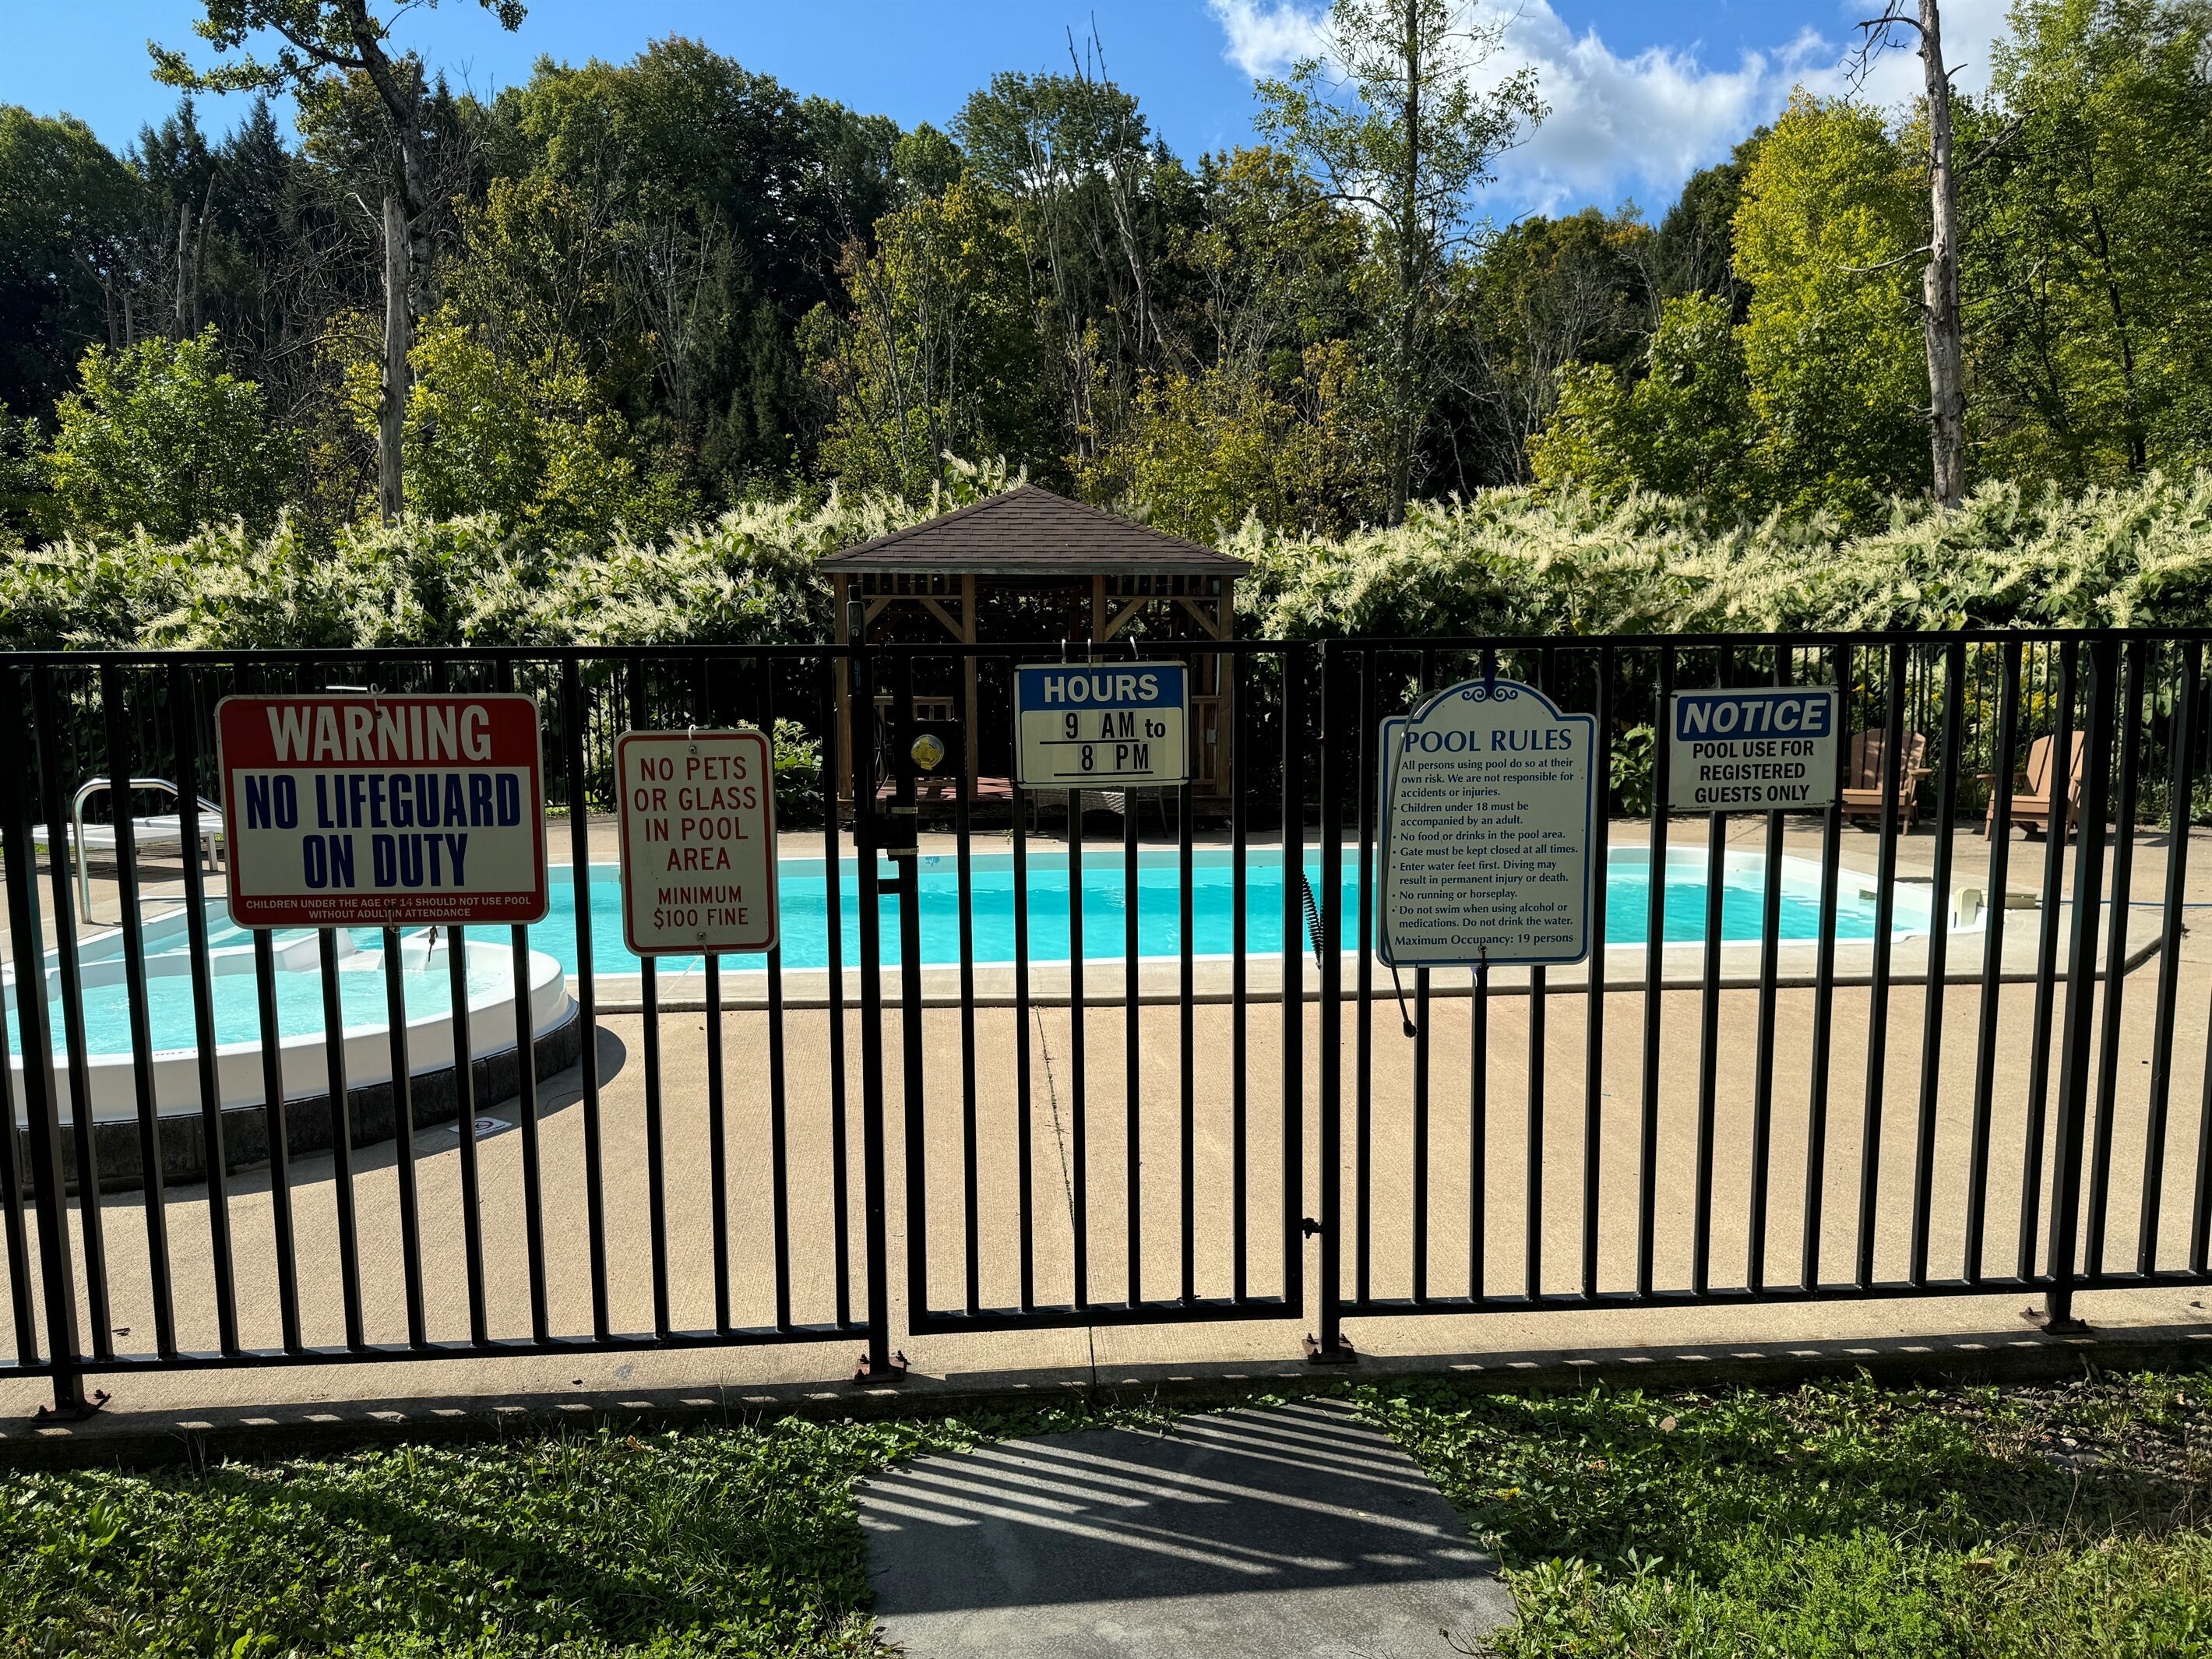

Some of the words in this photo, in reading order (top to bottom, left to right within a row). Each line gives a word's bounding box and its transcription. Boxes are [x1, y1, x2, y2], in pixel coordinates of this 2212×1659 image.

[1044, 675, 1158, 702] HOURS
[1683, 699, 1826, 734] NOTICE
[266, 705, 491, 762] WARNING
[1065, 713, 1078, 739] 9
[1101, 712, 1134, 738] AM
[1145, 719, 1165, 738] to
[1405, 731, 1481, 752] POOL
[1491, 728, 1572, 752] RULES
[1081, 745, 1093, 771] 8
[1116, 744, 1148, 770] PM
[1693, 742, 1738, 759] POOL
[1743, 741, 1776, 757] USE
[1781, 741, 1813, 756] FOR
[640, 757, 673, 781] NO
[687, 756, 746, 780] PETS
[1402, 759, 1414, 770] All
[1418, 759, 1454, 772] persons
[1458, 759, 1482, 770] using
[1486, 758, 1506, 770] pool
[1510, 758, 1522, 768] do
[1538, 759, 1548, 767] at
[1551, 757, 1573, 766] their
[1700, 763, 1805, 780] REGISTERED
[1401, 775, 1421, 784] own
[1425, 773, 1444, 783] risk.
[1447, 773, 1463, 783] We
[1485, 773, 1500, 782] not
[1503, 771, 1557, 784] responsible
[1560, 771, 1574, 780] for
[634, 788, 667, 812] OR
[679, 787, 756, 811] GLASS
[1401, 787, 1446, 798] accidents
[1449, 788, 1459, 797] or
[1463, 787, 1500, 798] injuries.
[1695, 786, 1762, 803] GUESTS
[1767, 785, 1810, 801] ONLY
[245, 775, 298, 830] NO
[315, 773, 520, 829] LIFEGUARD
[1400, 802, 1441, 812] Children
[1445, 802, 1472, 812] under
[1477, 802, 1488, 811] 18
[1517, 801, 1528, 810] be
[645, 818, 668, 841] IN
[682, 816, 748, 841] POOL
[1400, 815, 1464, 828] accompanied
[1467, 815, 1478, 827] by
[1496, 815, 1523, 824] adult.
[1400, 831, 1414, 841] No
[1418, 830, 1439, 840] food
[1456, 830, 1485, 840] drinks
[1488, 830, 1497, 839] in
[1500, 830, 1515, 839] the
[1518, 830, 1539, 841] pool
[667, 847, 731, 871] AREA
[1400, 847, 1423, 856] Gate
[1453, 845, 1464, 855] be
[1467, 845, 1488, 857] kept
[1491, 844, 1520, 854] closed
[1523, 845, 1533, 854] at
[1535, 844, 1547, 854] all
[1550, 844, 1578, 853] times.
[303, 834, 355, 888] ON
[372, 833, 468, 887] DUTY
[1400, 861, 1425, 871] Enter
[1428, 861, 1454, 870] water
[1458, 861, 1475, 869] feet
[1479, 860, 1499, 869] first.
[1503, 859, 1534, 871] Diving
[1537, 860, 1557, 870] may
[1400, 875, 1425, 885] result
[1429, 875, 1438, 884] in
[1441, 875, 1492, 886] permanent
[1495, 873, 1523, 885] injury
[1539, 872, 1568, 882] death.
[246, 899, 298, 910] CHILDREN
[301, 899, 336, 908] UNDER
[337, 899, 358, 907] THE
[360, 898, 382, 907] AGE
[384, 898, 397, 907] OF
[400, 898, 413, 907] 14
[415, 897, 456, 907] SHOULD
[459, 897, 479, 906] NOT
[481, 896, 502, 905] USE
[505, 896, 531, 905] POOL
[658, 886, 741, 905] MINIMUM
[1400, 890, 1414, 900] No
[1418, 890, 1453, 901] running
[1470, 889, 1517, 900] horseplay.
[309, 910, 354, 919] WITHOUT
[357, 909, 388, 918] ADULT
[392, 909, 402, 918] IN
[405, 908, 470, 918] ATTENDANCE
[1400, 905, 1413, 914] Do
[1417, 905, 1432, 914] not
[1435, 904, 1460, 914] swim
[1463, 903, 1488, 913] when
[1492, 903, 1516, 914] using
[1520, 902, 1554, 912] alcohol
[1558, 903, 1567, 911] or
[653, 908, 698, 930] $100
[707, 907, 748, 926] FINE
[1400, 918, 1459, 928] medications.
[1463, 918, 1476, 927] Do
[1480, 918, 1495, 926] not
[1499, 916, 1523, 926] drink
[1527, 916, 1541, 925] the
[1544, 916, 1573, 925] water.
[1395, 935, 1446, 946] Maximum
[1451, 934, 1513, 946] Occupancy:
[1517, 934, 1530, 943] 19
[1534, 934, 1573, 945] persons
